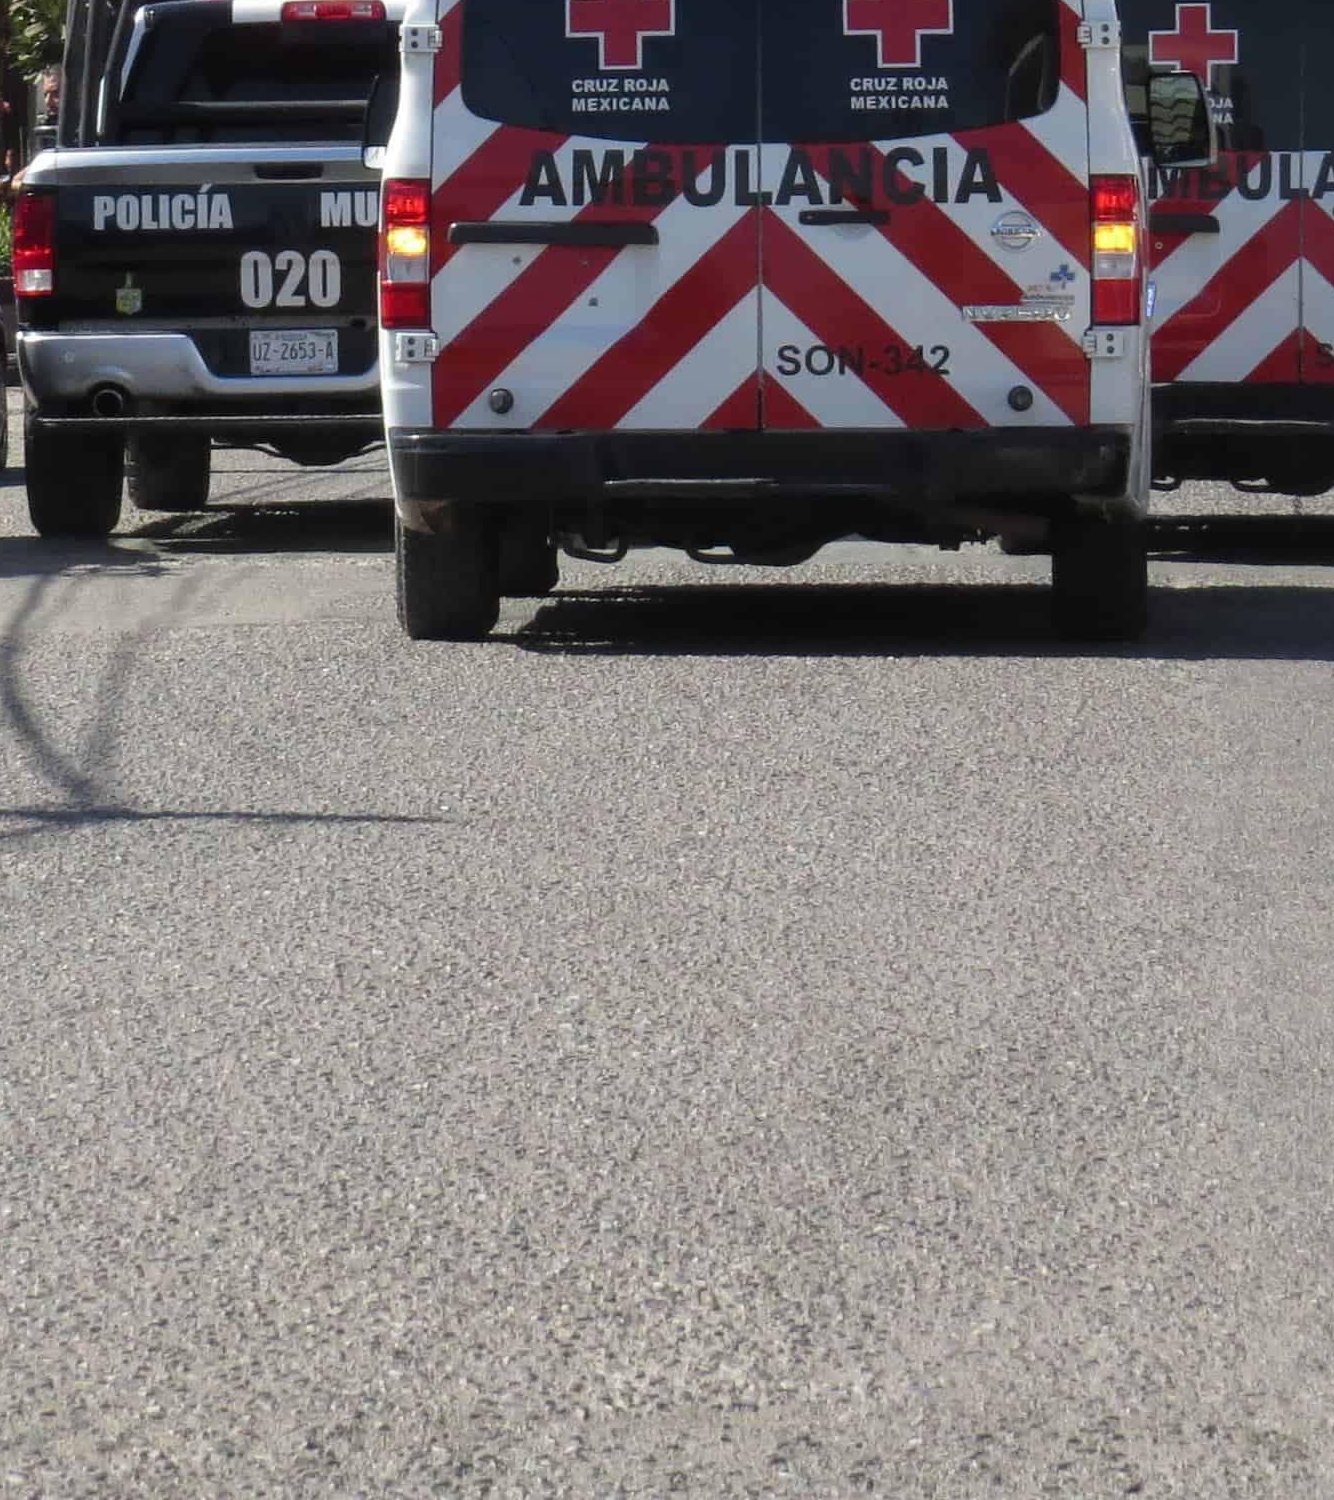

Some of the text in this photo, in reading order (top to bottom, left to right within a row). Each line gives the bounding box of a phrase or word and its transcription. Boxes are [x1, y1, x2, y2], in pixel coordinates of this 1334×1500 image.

[572, 77, 670, 93] CRUZ ROJA
[850, 76, 949, 92] CRUZ ROJA
[572, 97, 670, 112] MEXICANA
[850, 95, 949, 110] MEXICANA
[519, 146, 1003, 207] AMBULANCIA
[93, 183, 234, 230] POLICÍA
[240, 250, 342, 308] 020
[776, 345, 951, 376] SON-342
